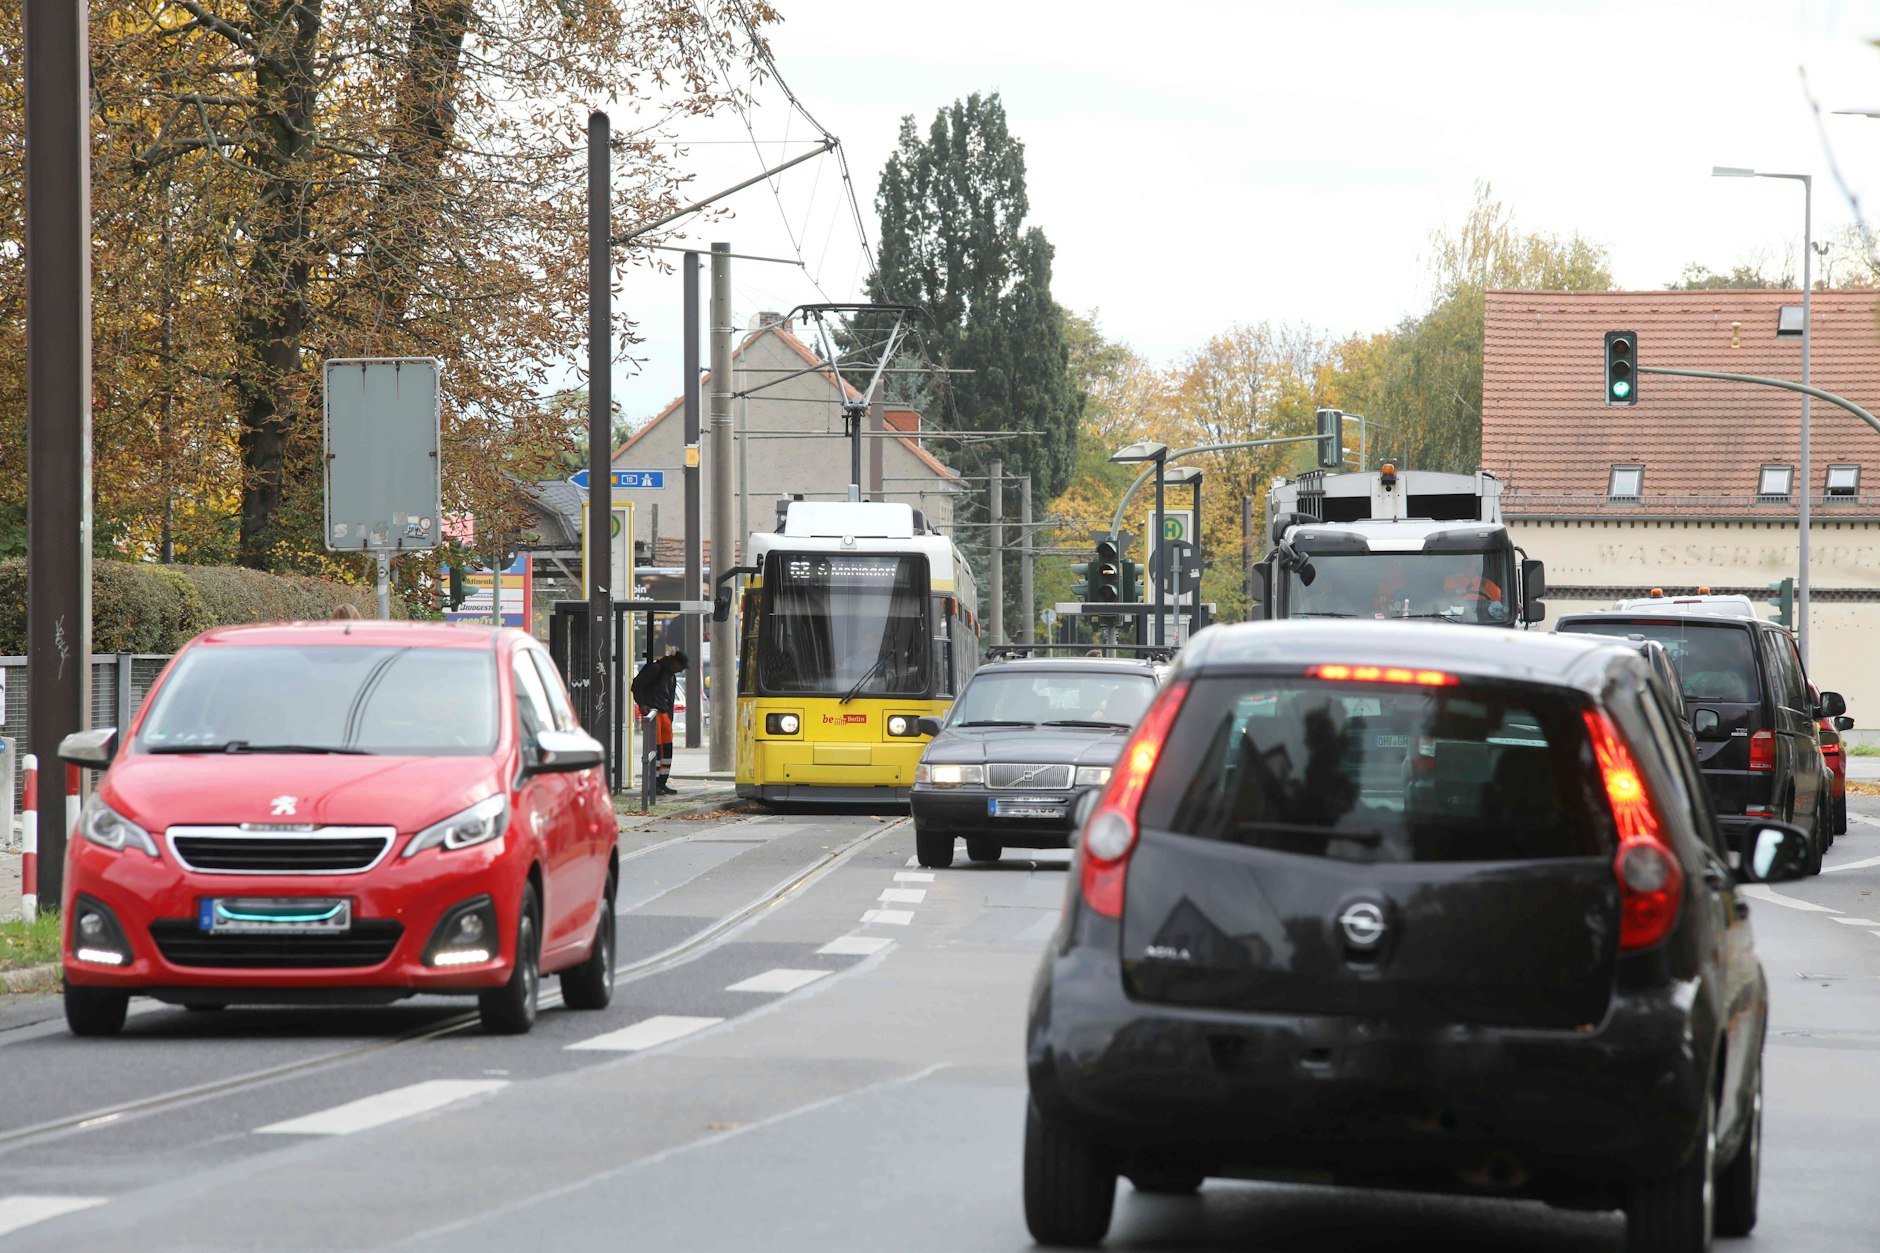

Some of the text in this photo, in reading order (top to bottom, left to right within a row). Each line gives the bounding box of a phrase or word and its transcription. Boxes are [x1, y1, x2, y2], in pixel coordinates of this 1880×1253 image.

[1164, 523, 1177, 537] H
[456, 617, 506, 625] GOODYER
[822, 714, 865, 724] be Berlin
